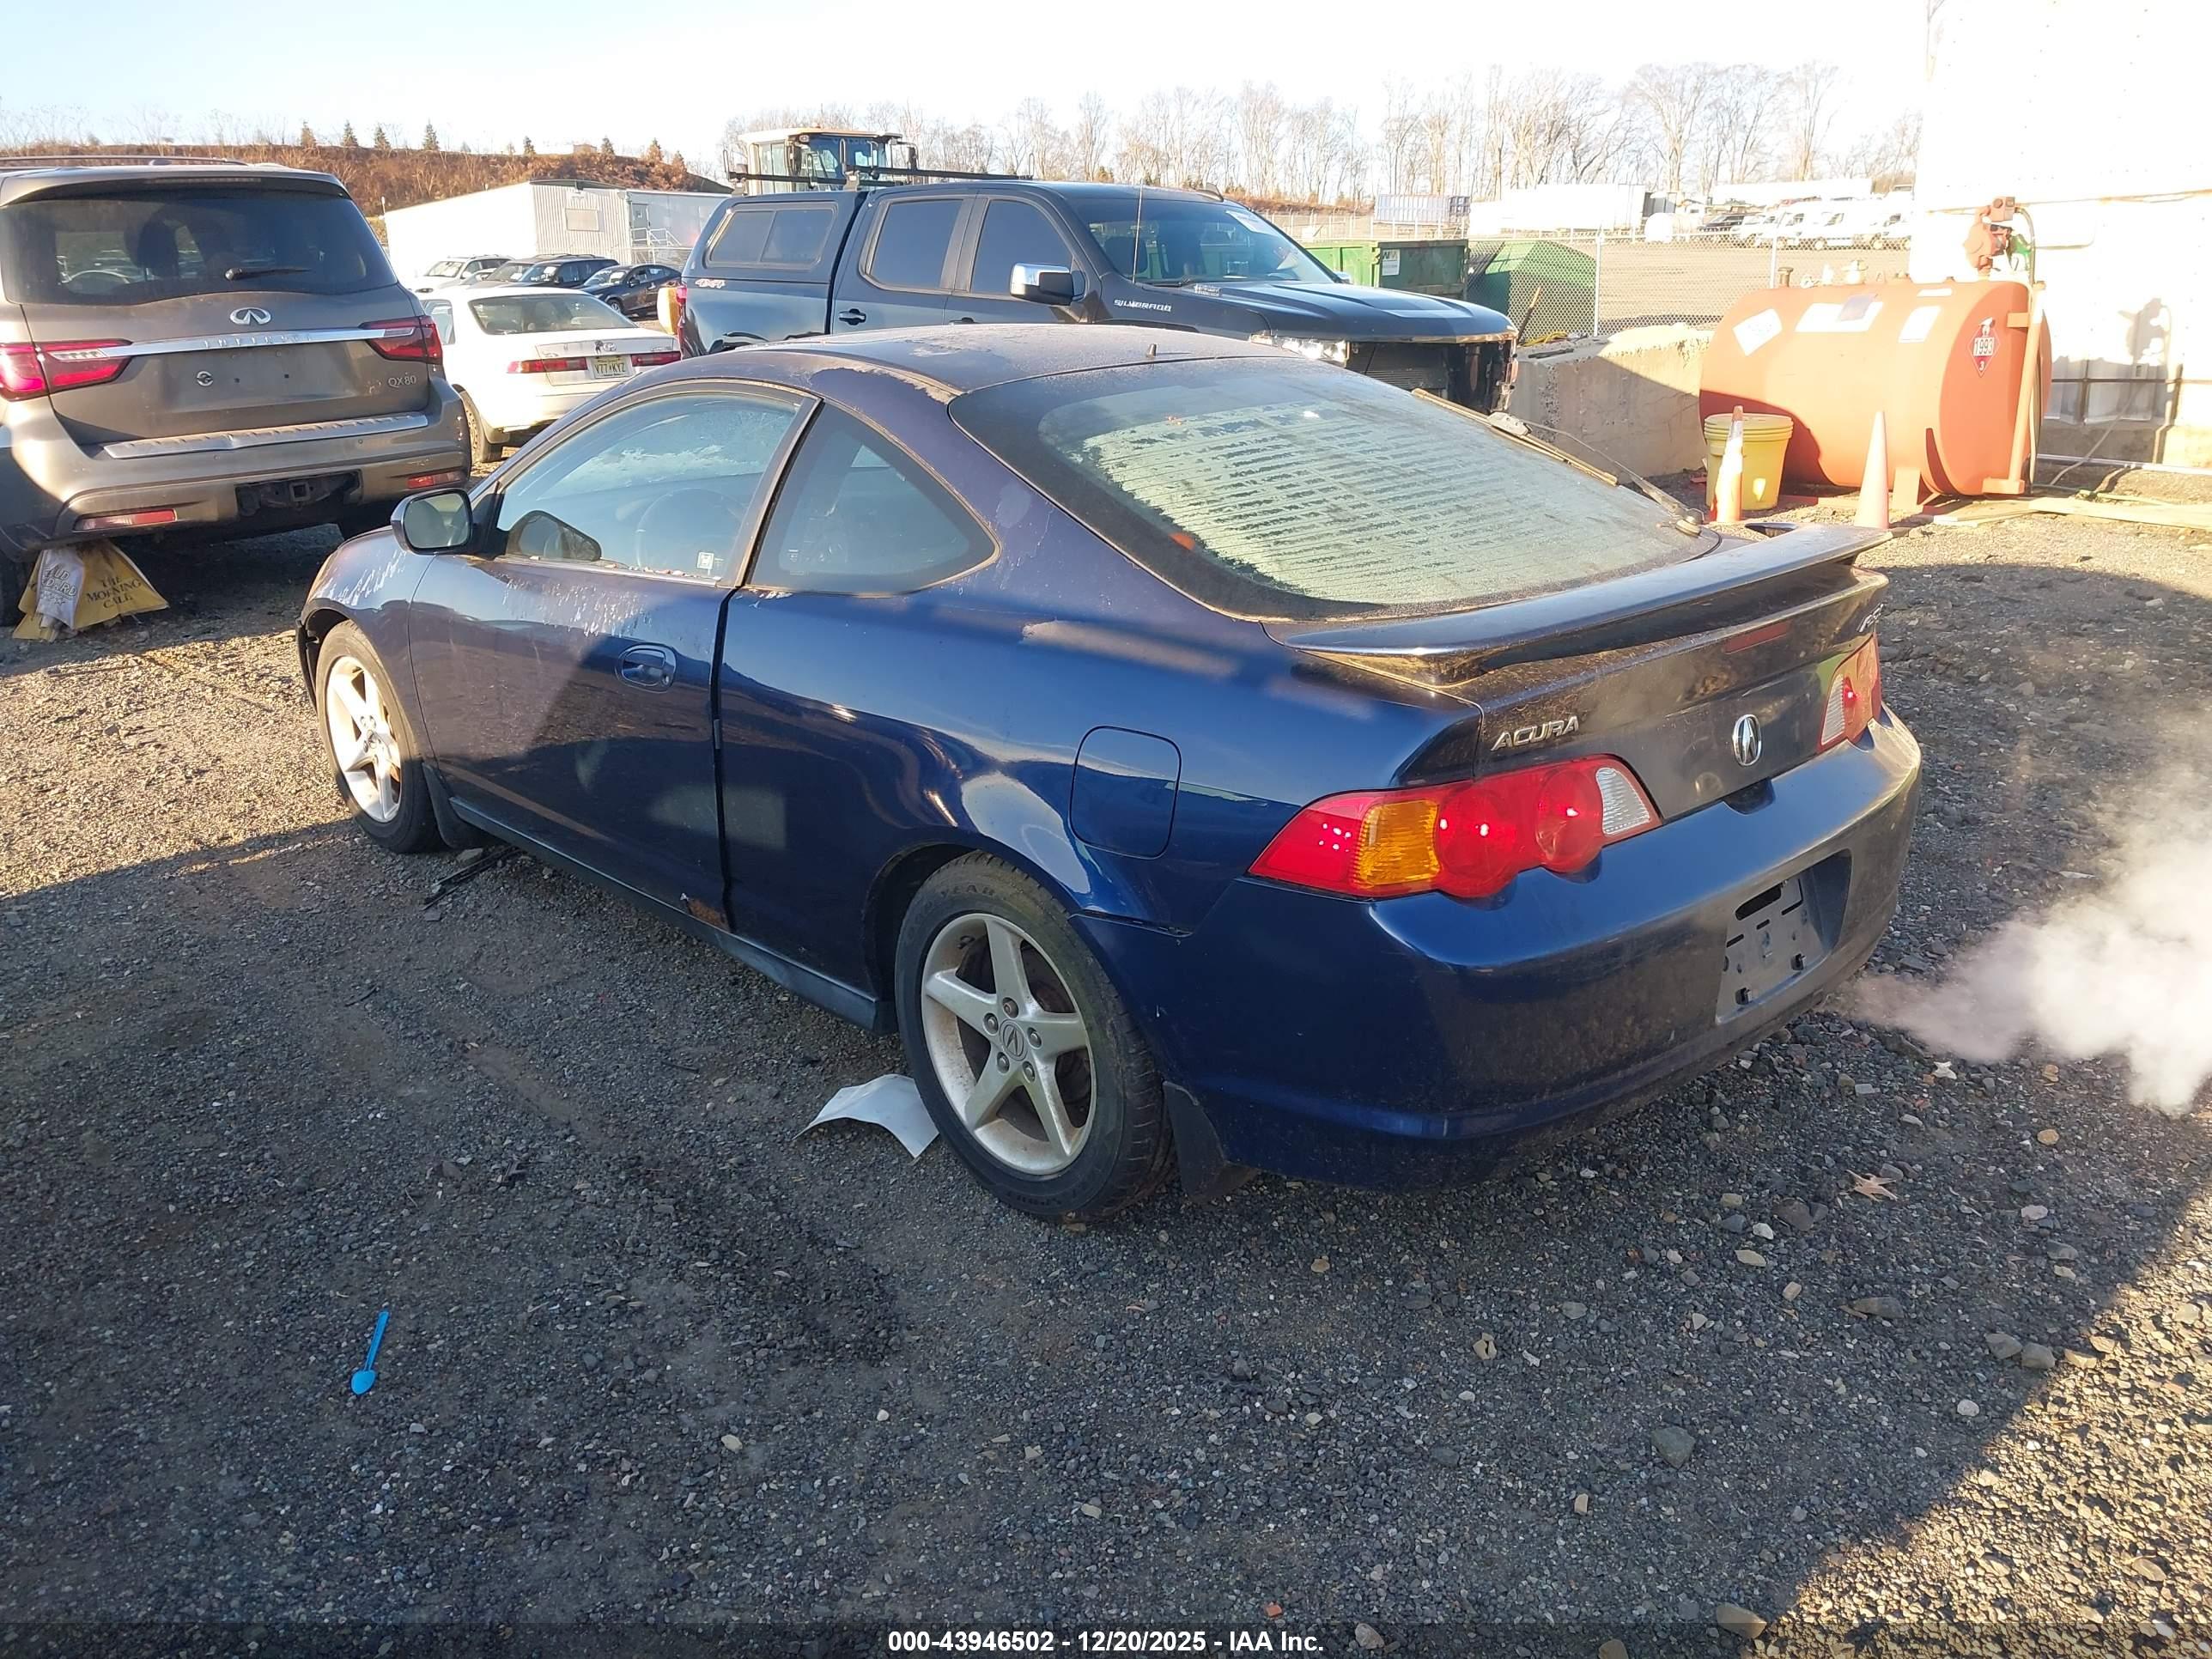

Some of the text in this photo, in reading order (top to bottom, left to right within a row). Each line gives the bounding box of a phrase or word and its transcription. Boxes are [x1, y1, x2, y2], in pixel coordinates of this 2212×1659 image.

[1114, 299, 1172, 313] SILVERADO
[1975, 338, 1993, 355] 1993
[1978, 361, 1985, 372] 3
[388, 374, 417, 388] QX80
[86, 578, 143, 604] MORNING
[1490, 715, 1579, 751] ACURA
